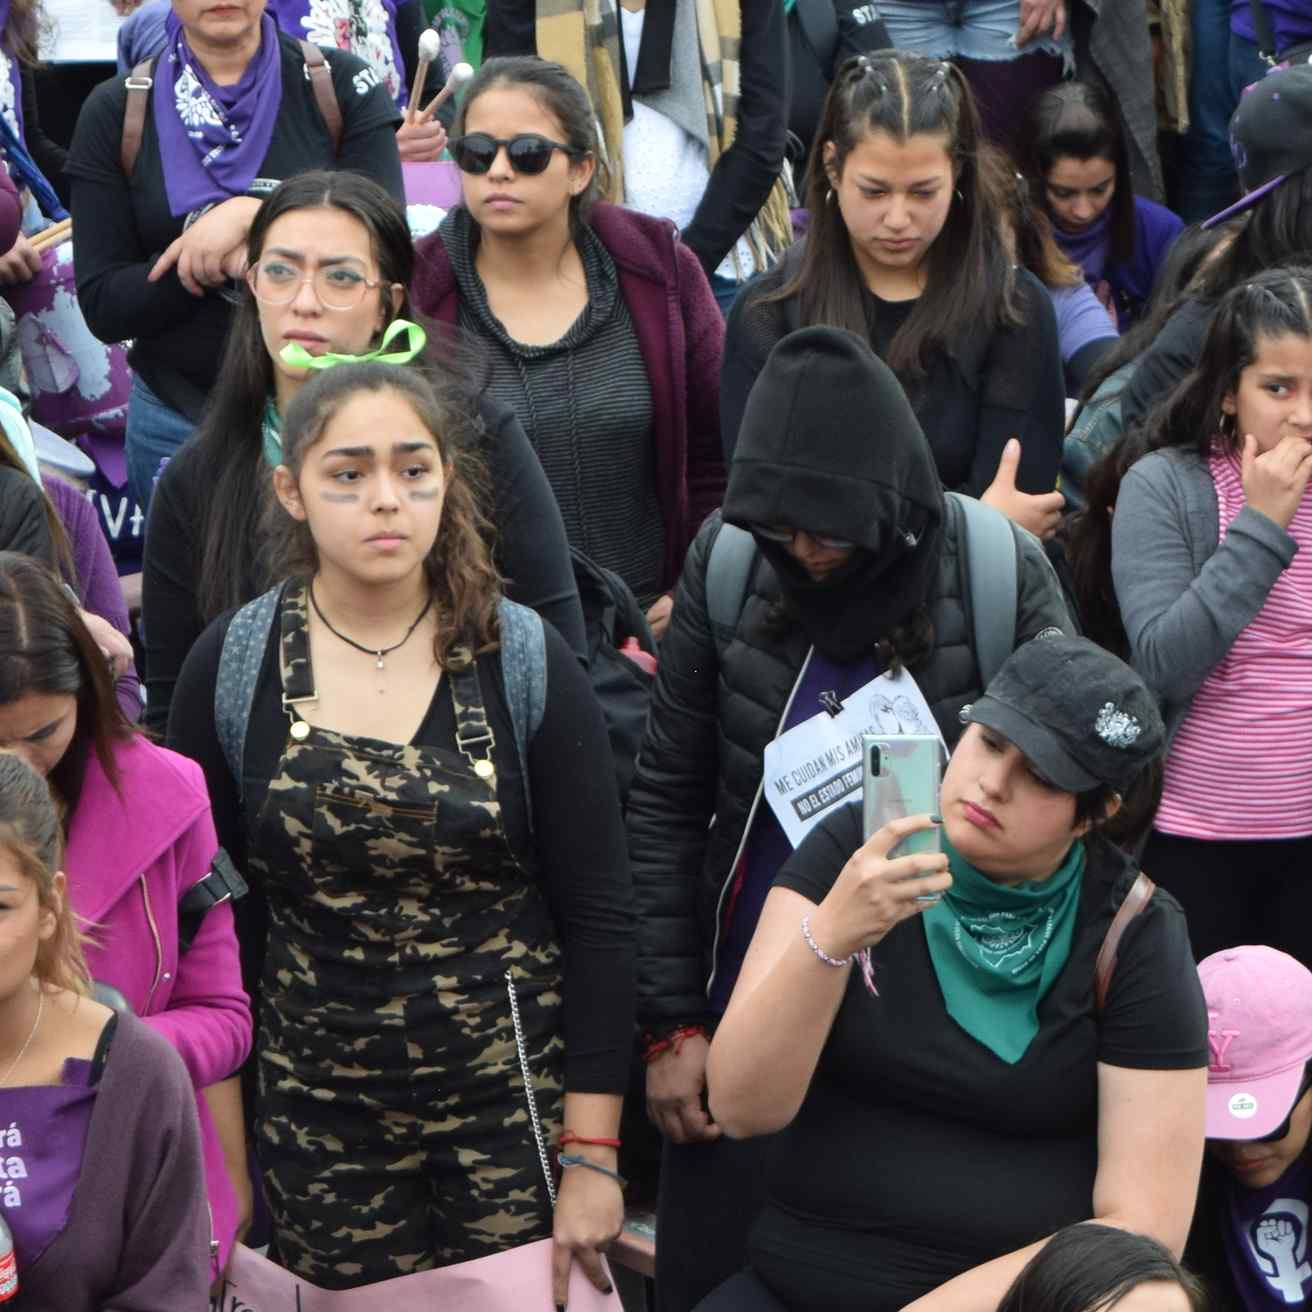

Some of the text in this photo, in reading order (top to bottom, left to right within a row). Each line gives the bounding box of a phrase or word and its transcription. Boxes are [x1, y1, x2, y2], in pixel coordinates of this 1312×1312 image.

[774, 776, 795, 796] ME
[792, 756, 828, 788] CUIDAN
[825, 744, 846, 770] MIS
[796, 795, 812, 816] NO
[819, 776, 846, 804] ESTADO
